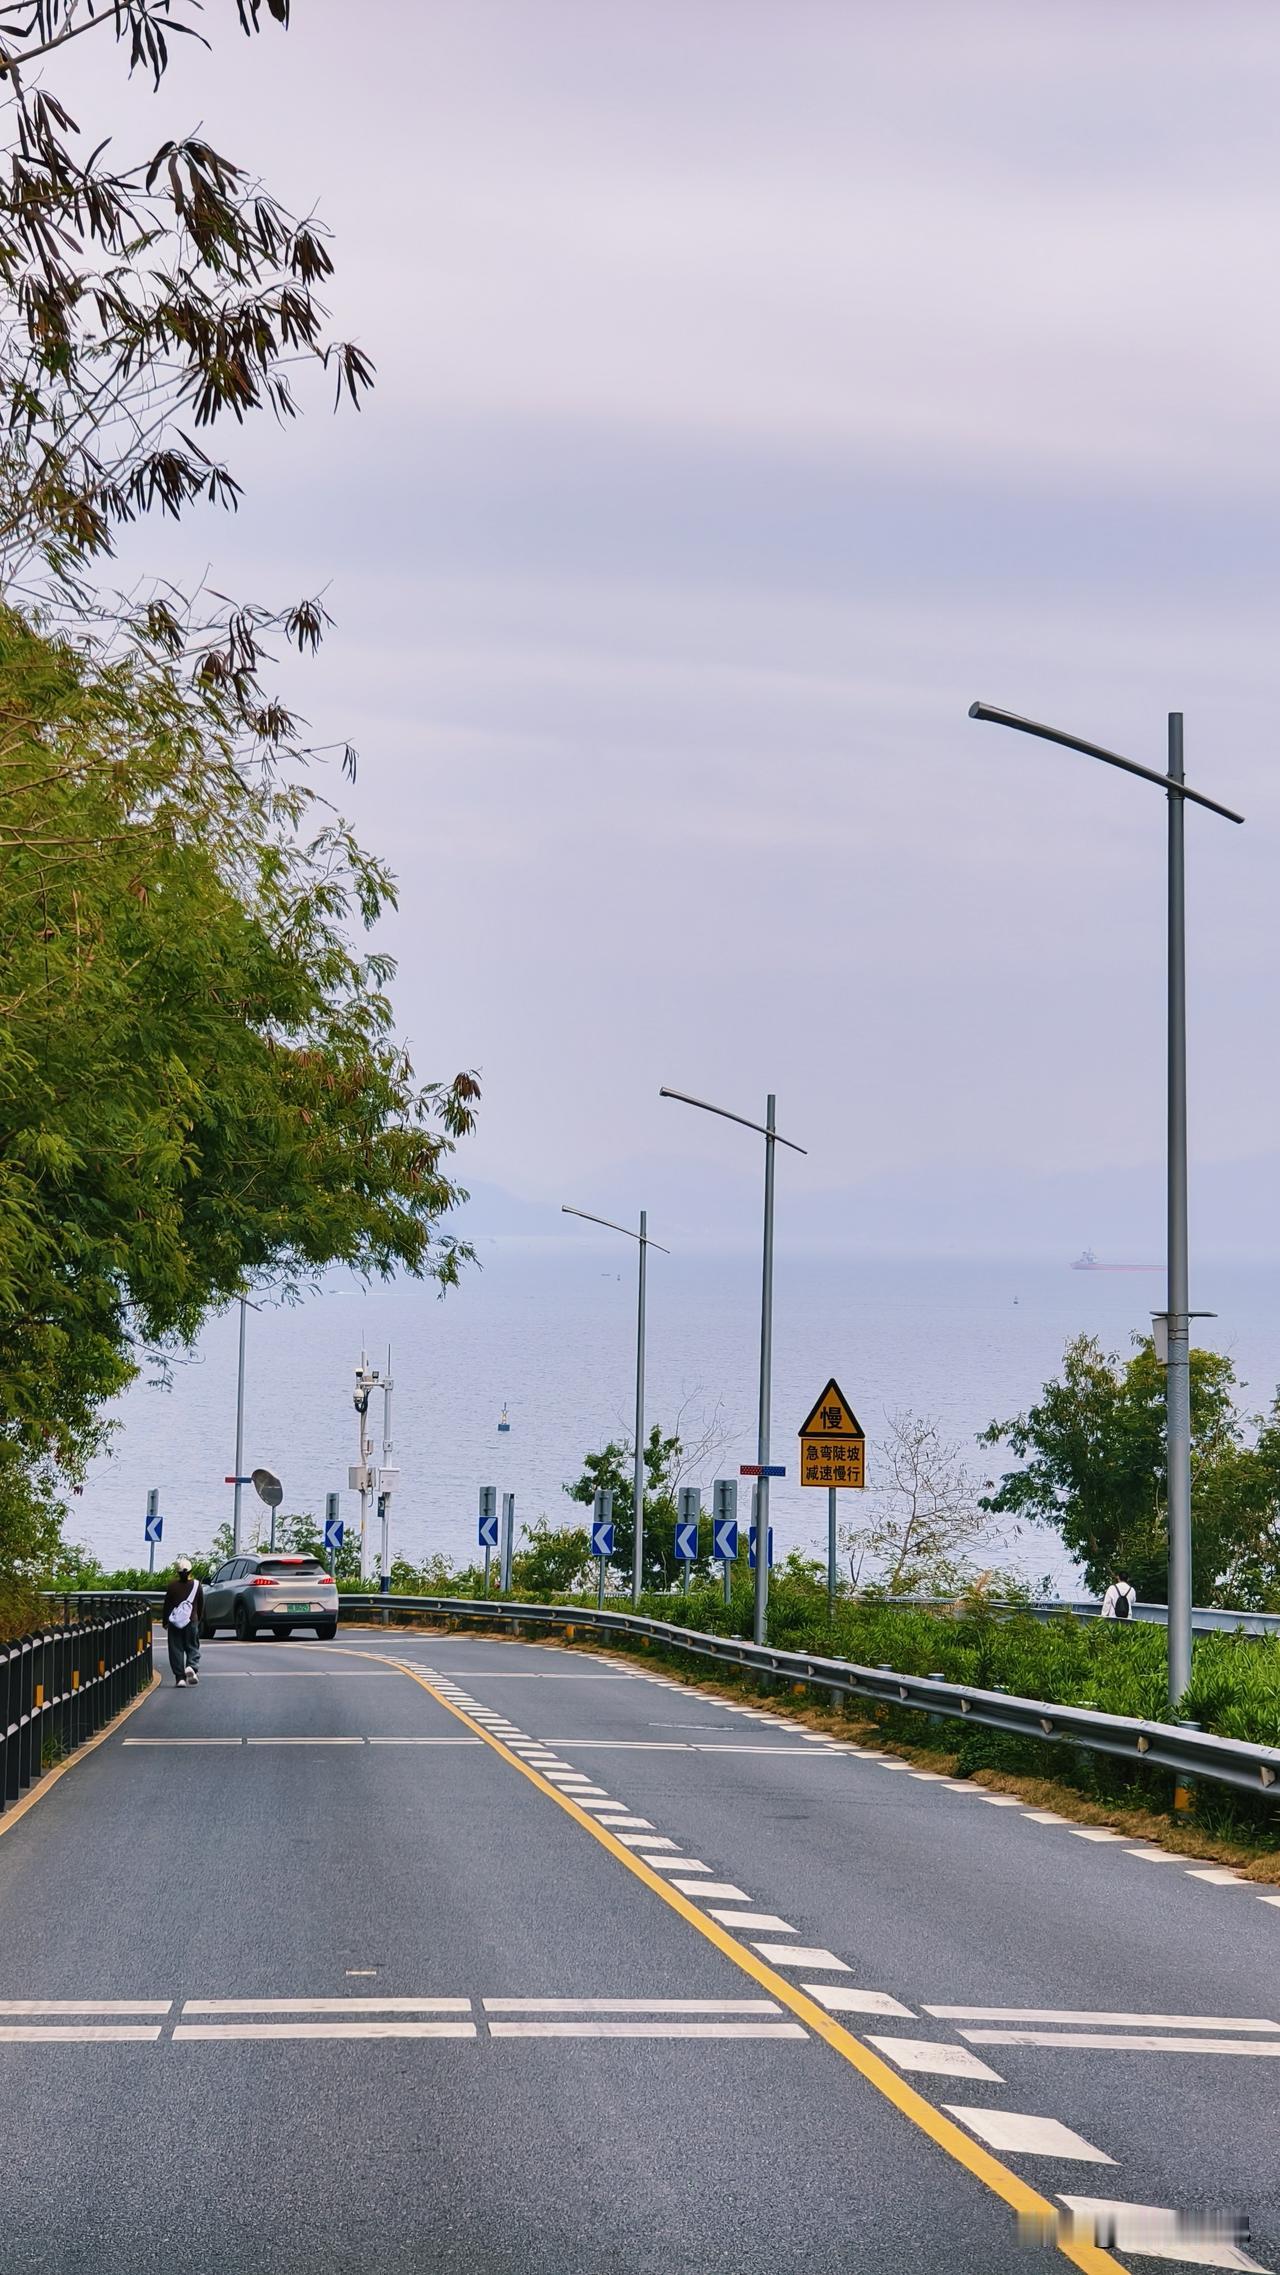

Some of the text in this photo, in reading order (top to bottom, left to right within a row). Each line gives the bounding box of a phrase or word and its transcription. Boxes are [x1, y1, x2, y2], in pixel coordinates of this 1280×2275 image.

[820, 1406, 843, 1430] 慢
[806, 1445, 860, 1461] 急弯陡坡
[806, 1466, 860, 1482] 减速慢行
